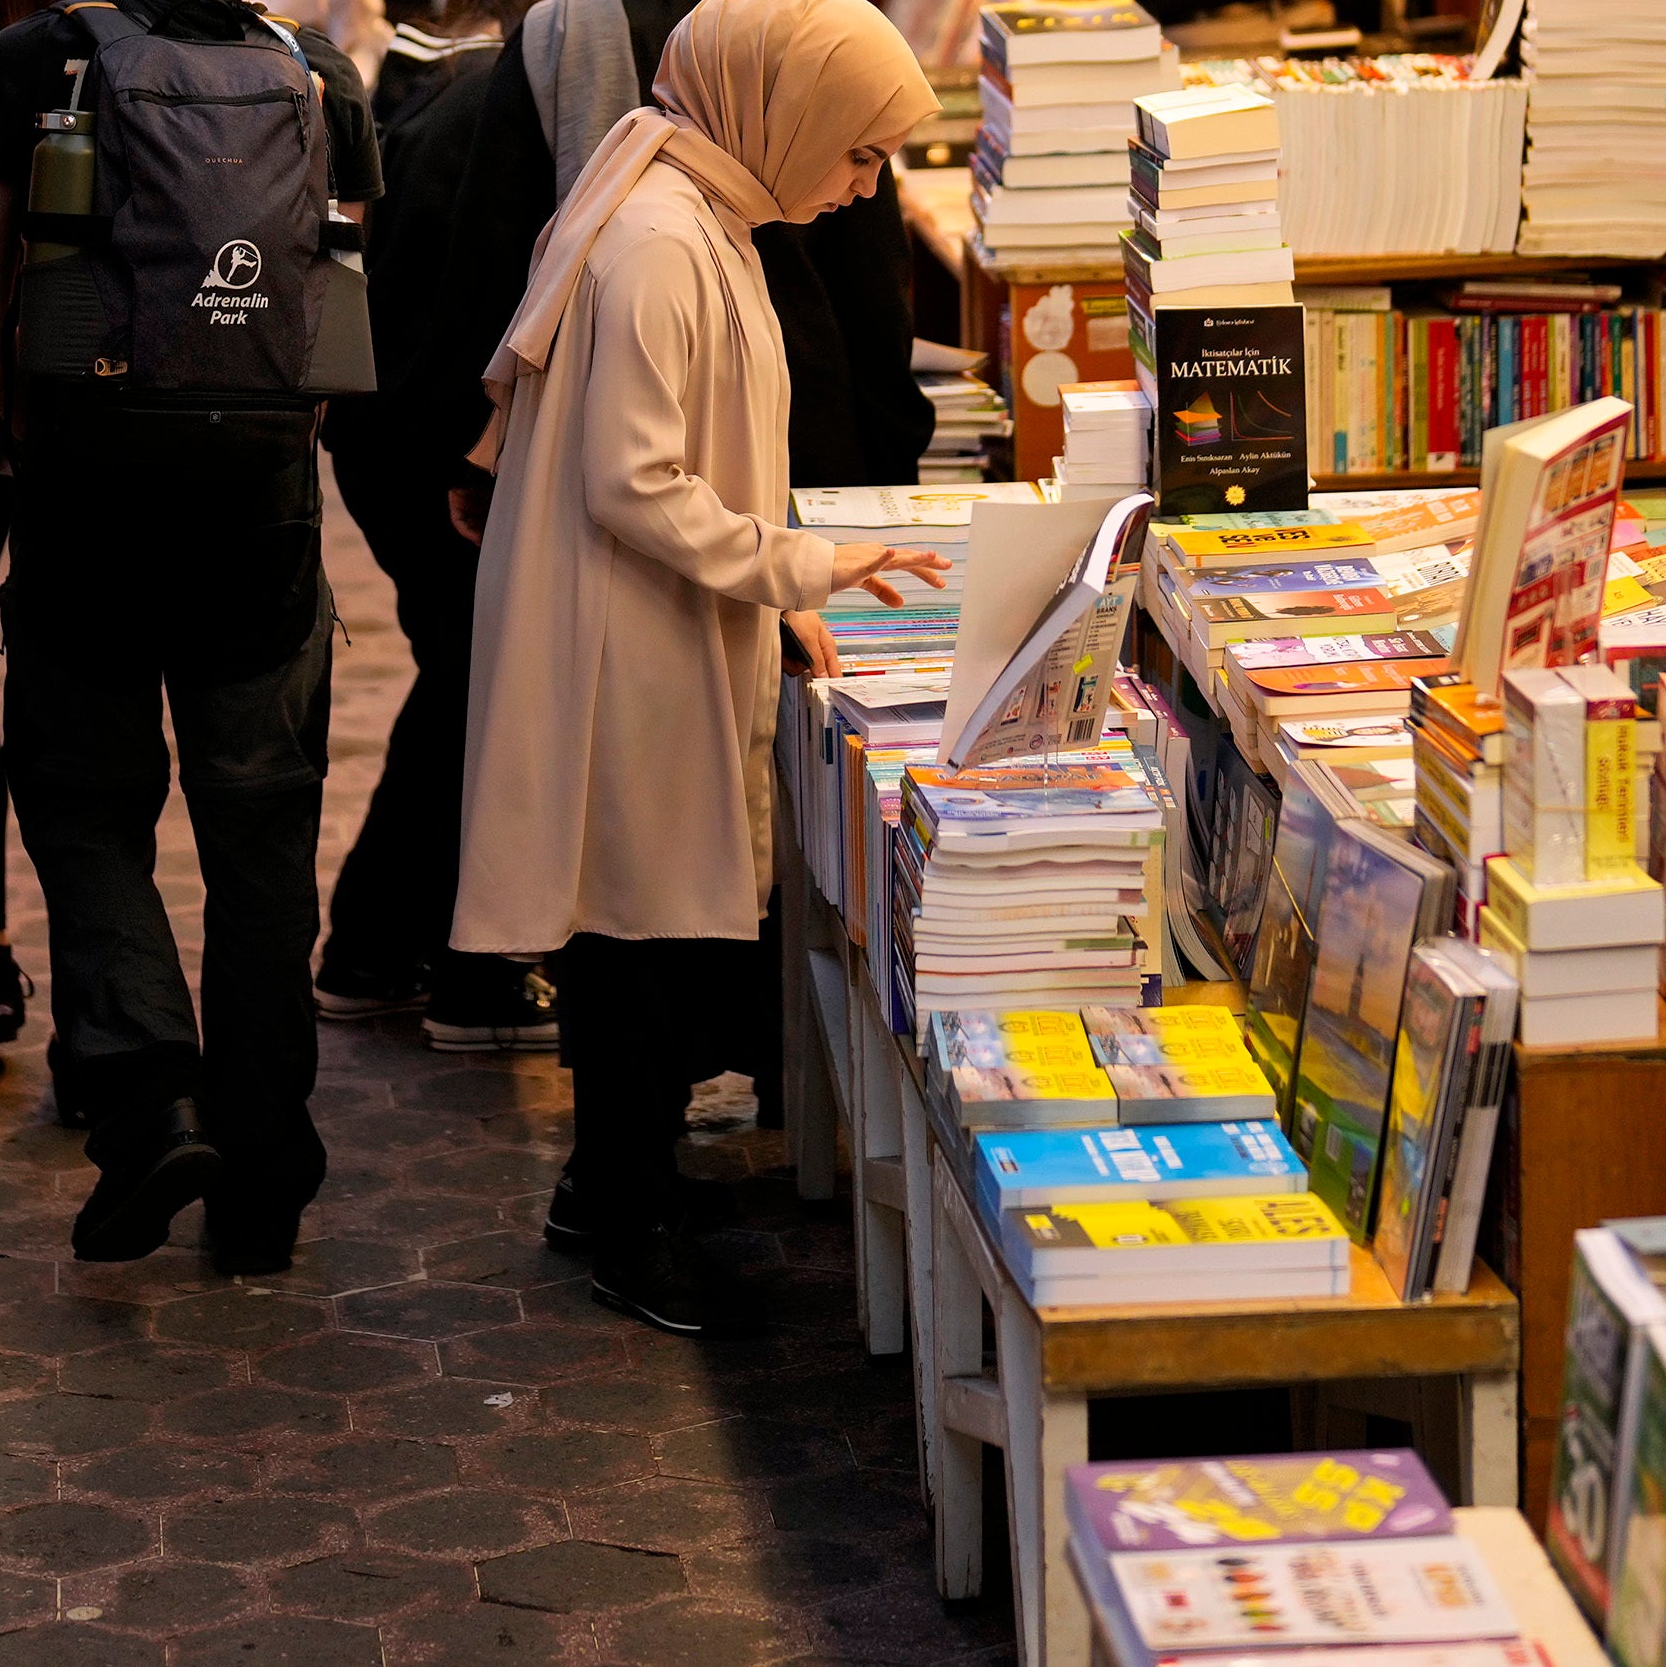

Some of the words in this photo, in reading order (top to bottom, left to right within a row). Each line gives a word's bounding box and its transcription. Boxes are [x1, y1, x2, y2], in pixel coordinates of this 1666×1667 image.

[191, 292, 269, 309] Adrenalin
[210, 310, 248, 325] Park
[1202, 348, 1243, 359] İktisatçılar
[1244, 347, 1260, 358] İçin
[1171, 355, 1292, 378] MATEMATİK
[1241, 465, 1261, 476] Akay
[1099, 596, 1119, 608] AYT
